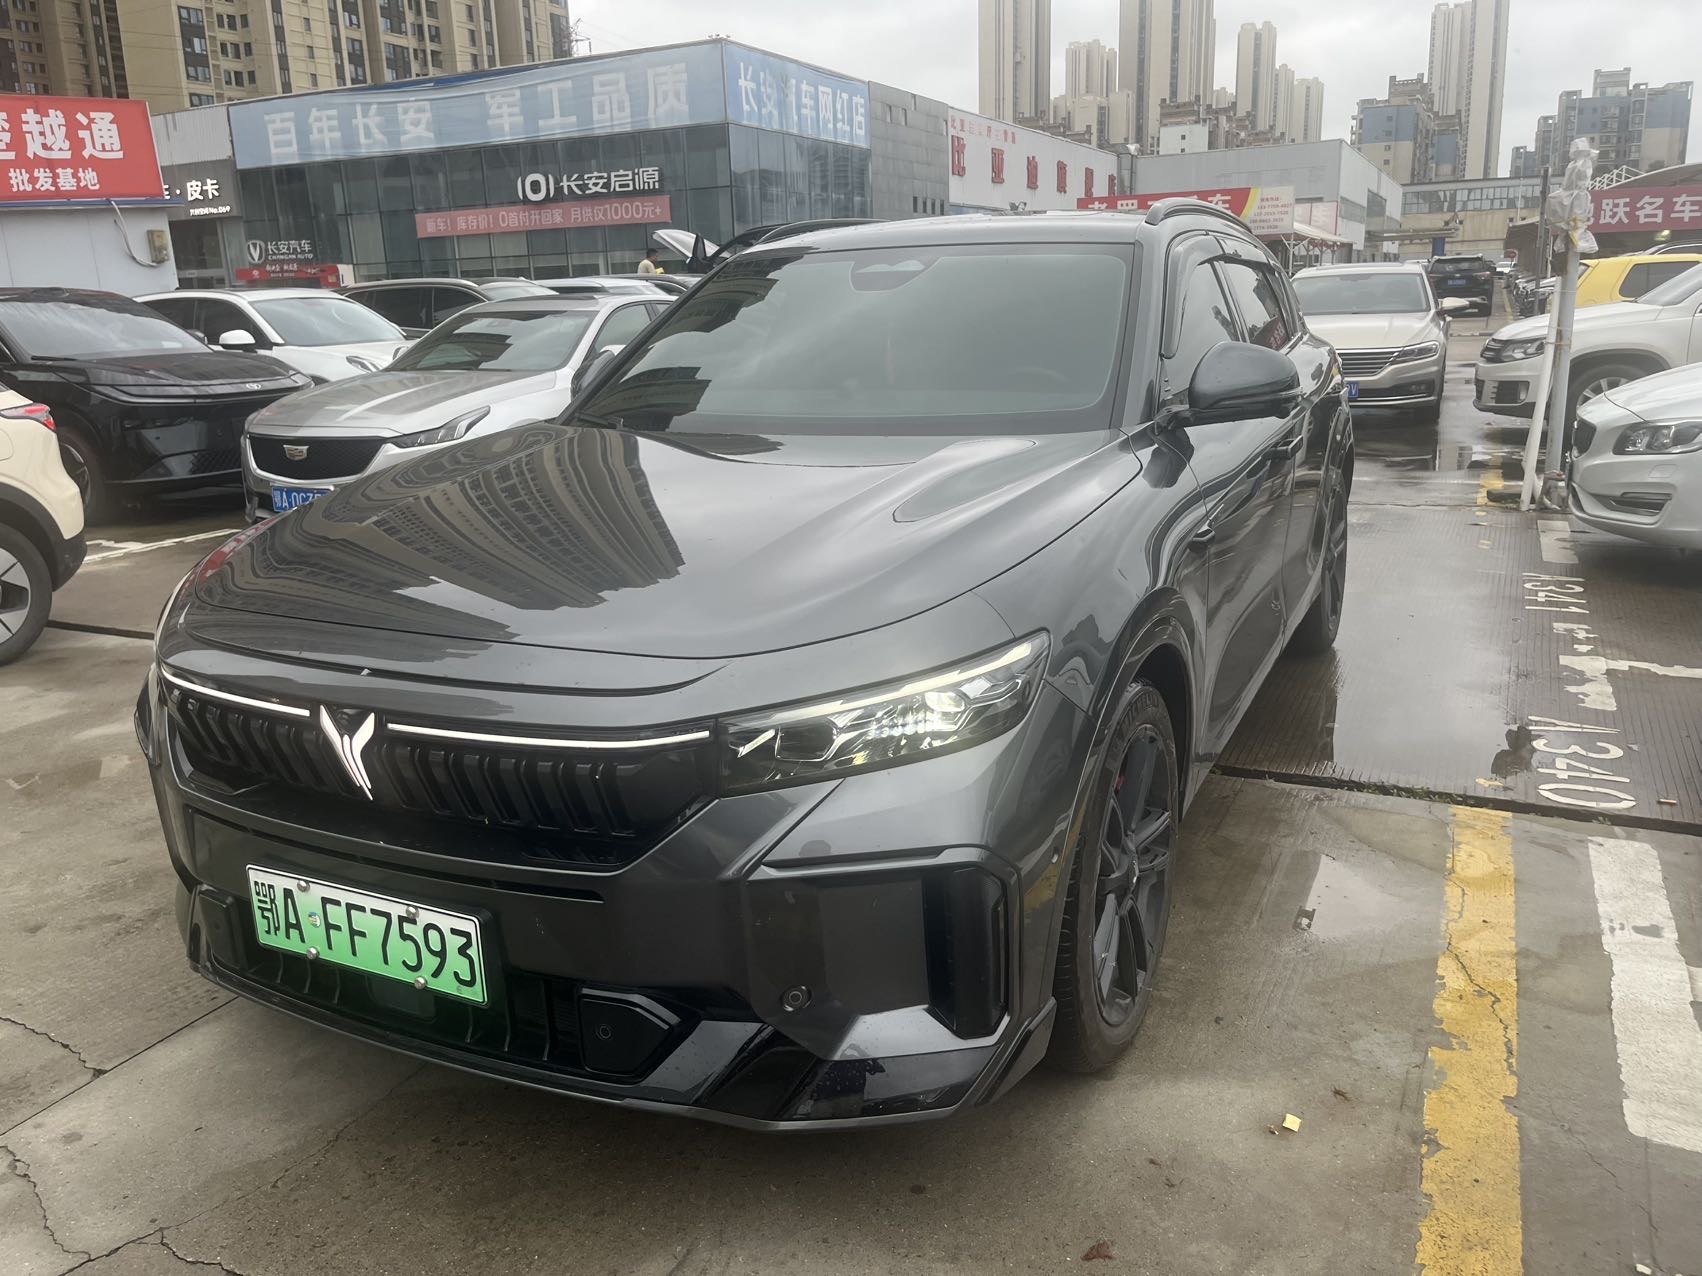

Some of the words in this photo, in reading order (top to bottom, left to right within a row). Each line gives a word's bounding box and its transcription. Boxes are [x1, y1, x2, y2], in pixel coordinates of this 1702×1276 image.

[263, 98, 434, 153] 百年长安
[485, 62, 689, 138] 军工品质
[8, 167, 100, 192] 批发基地
[560, 166, 659, 195] 长安启源
[1586, 193, 1702, 225] 跃名车
[267, 240, 313, 254] 长安汽车
[1522, 572, 1590, 613] A341
[1527, 715, 1637, 810] A340
